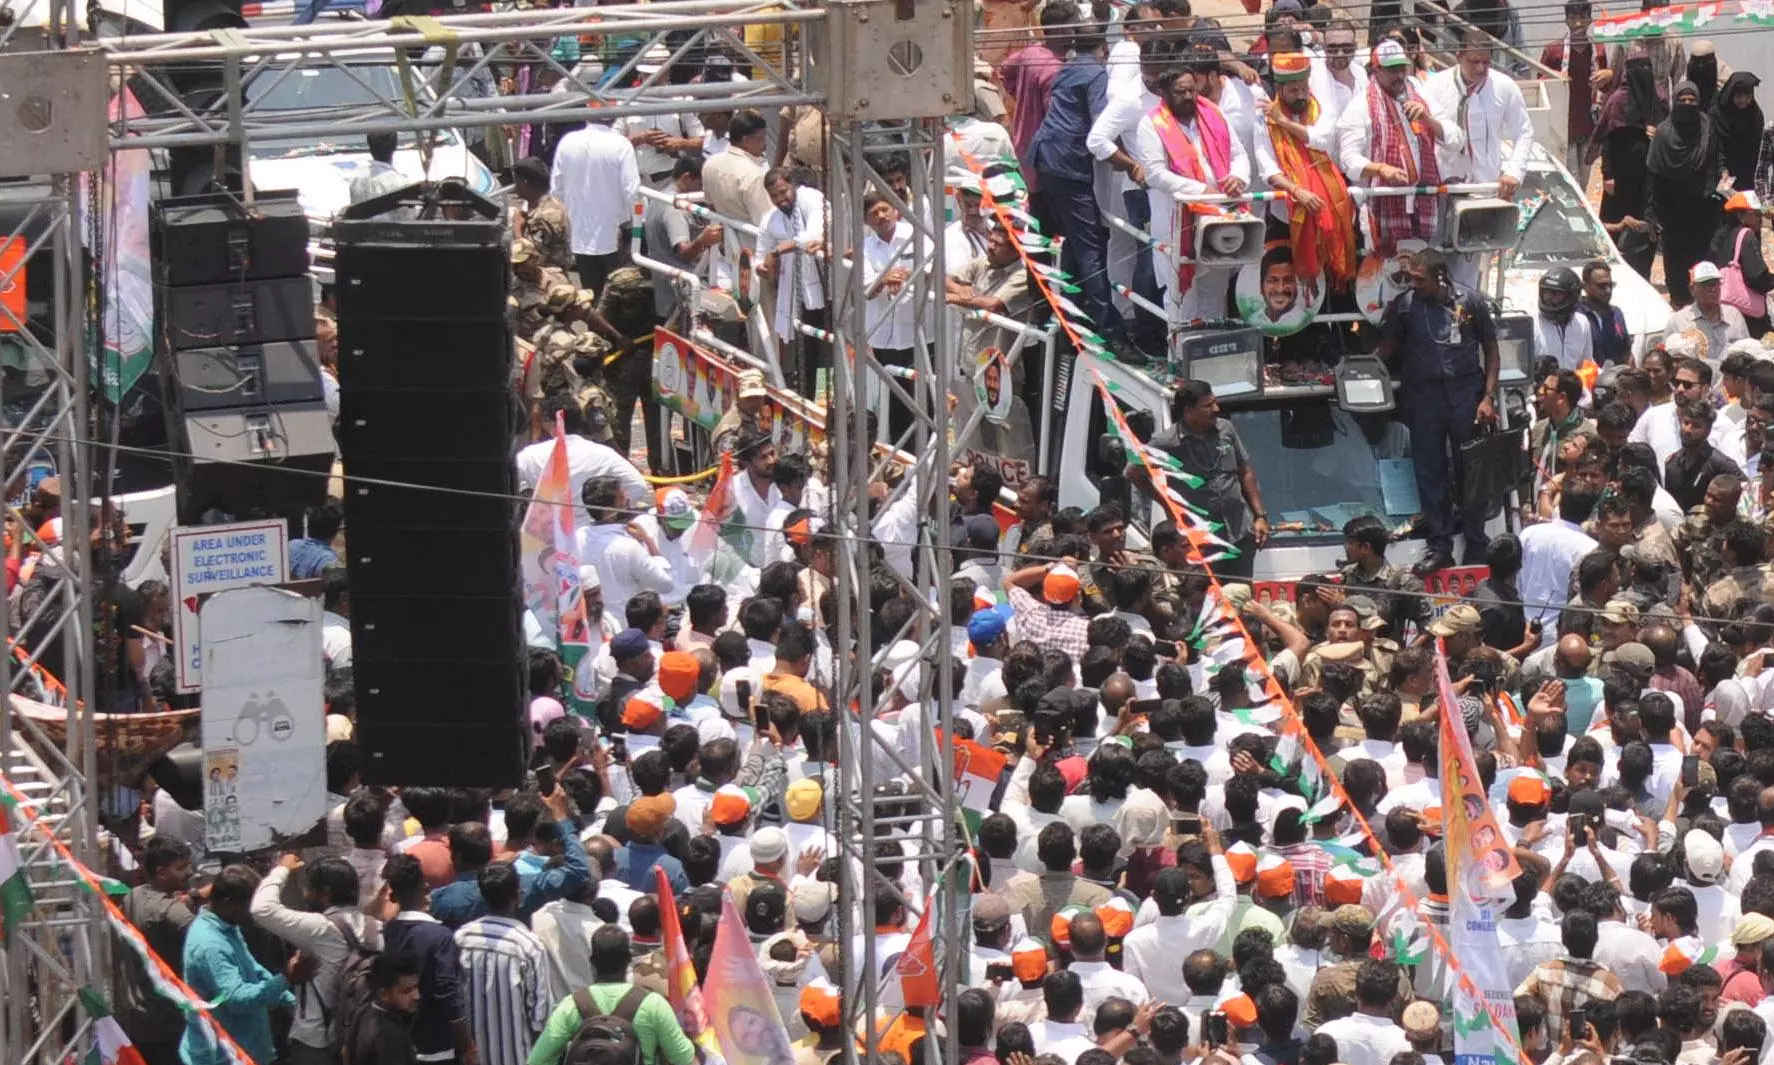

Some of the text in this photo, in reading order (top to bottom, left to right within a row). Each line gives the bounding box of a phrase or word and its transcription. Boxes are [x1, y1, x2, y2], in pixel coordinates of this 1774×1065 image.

[192, 533, 266, 552] AREA UNDER
[194, 549, 267, 567] ELECTRONIC
[187, 564, 275, 585] SURVEILLANCE
